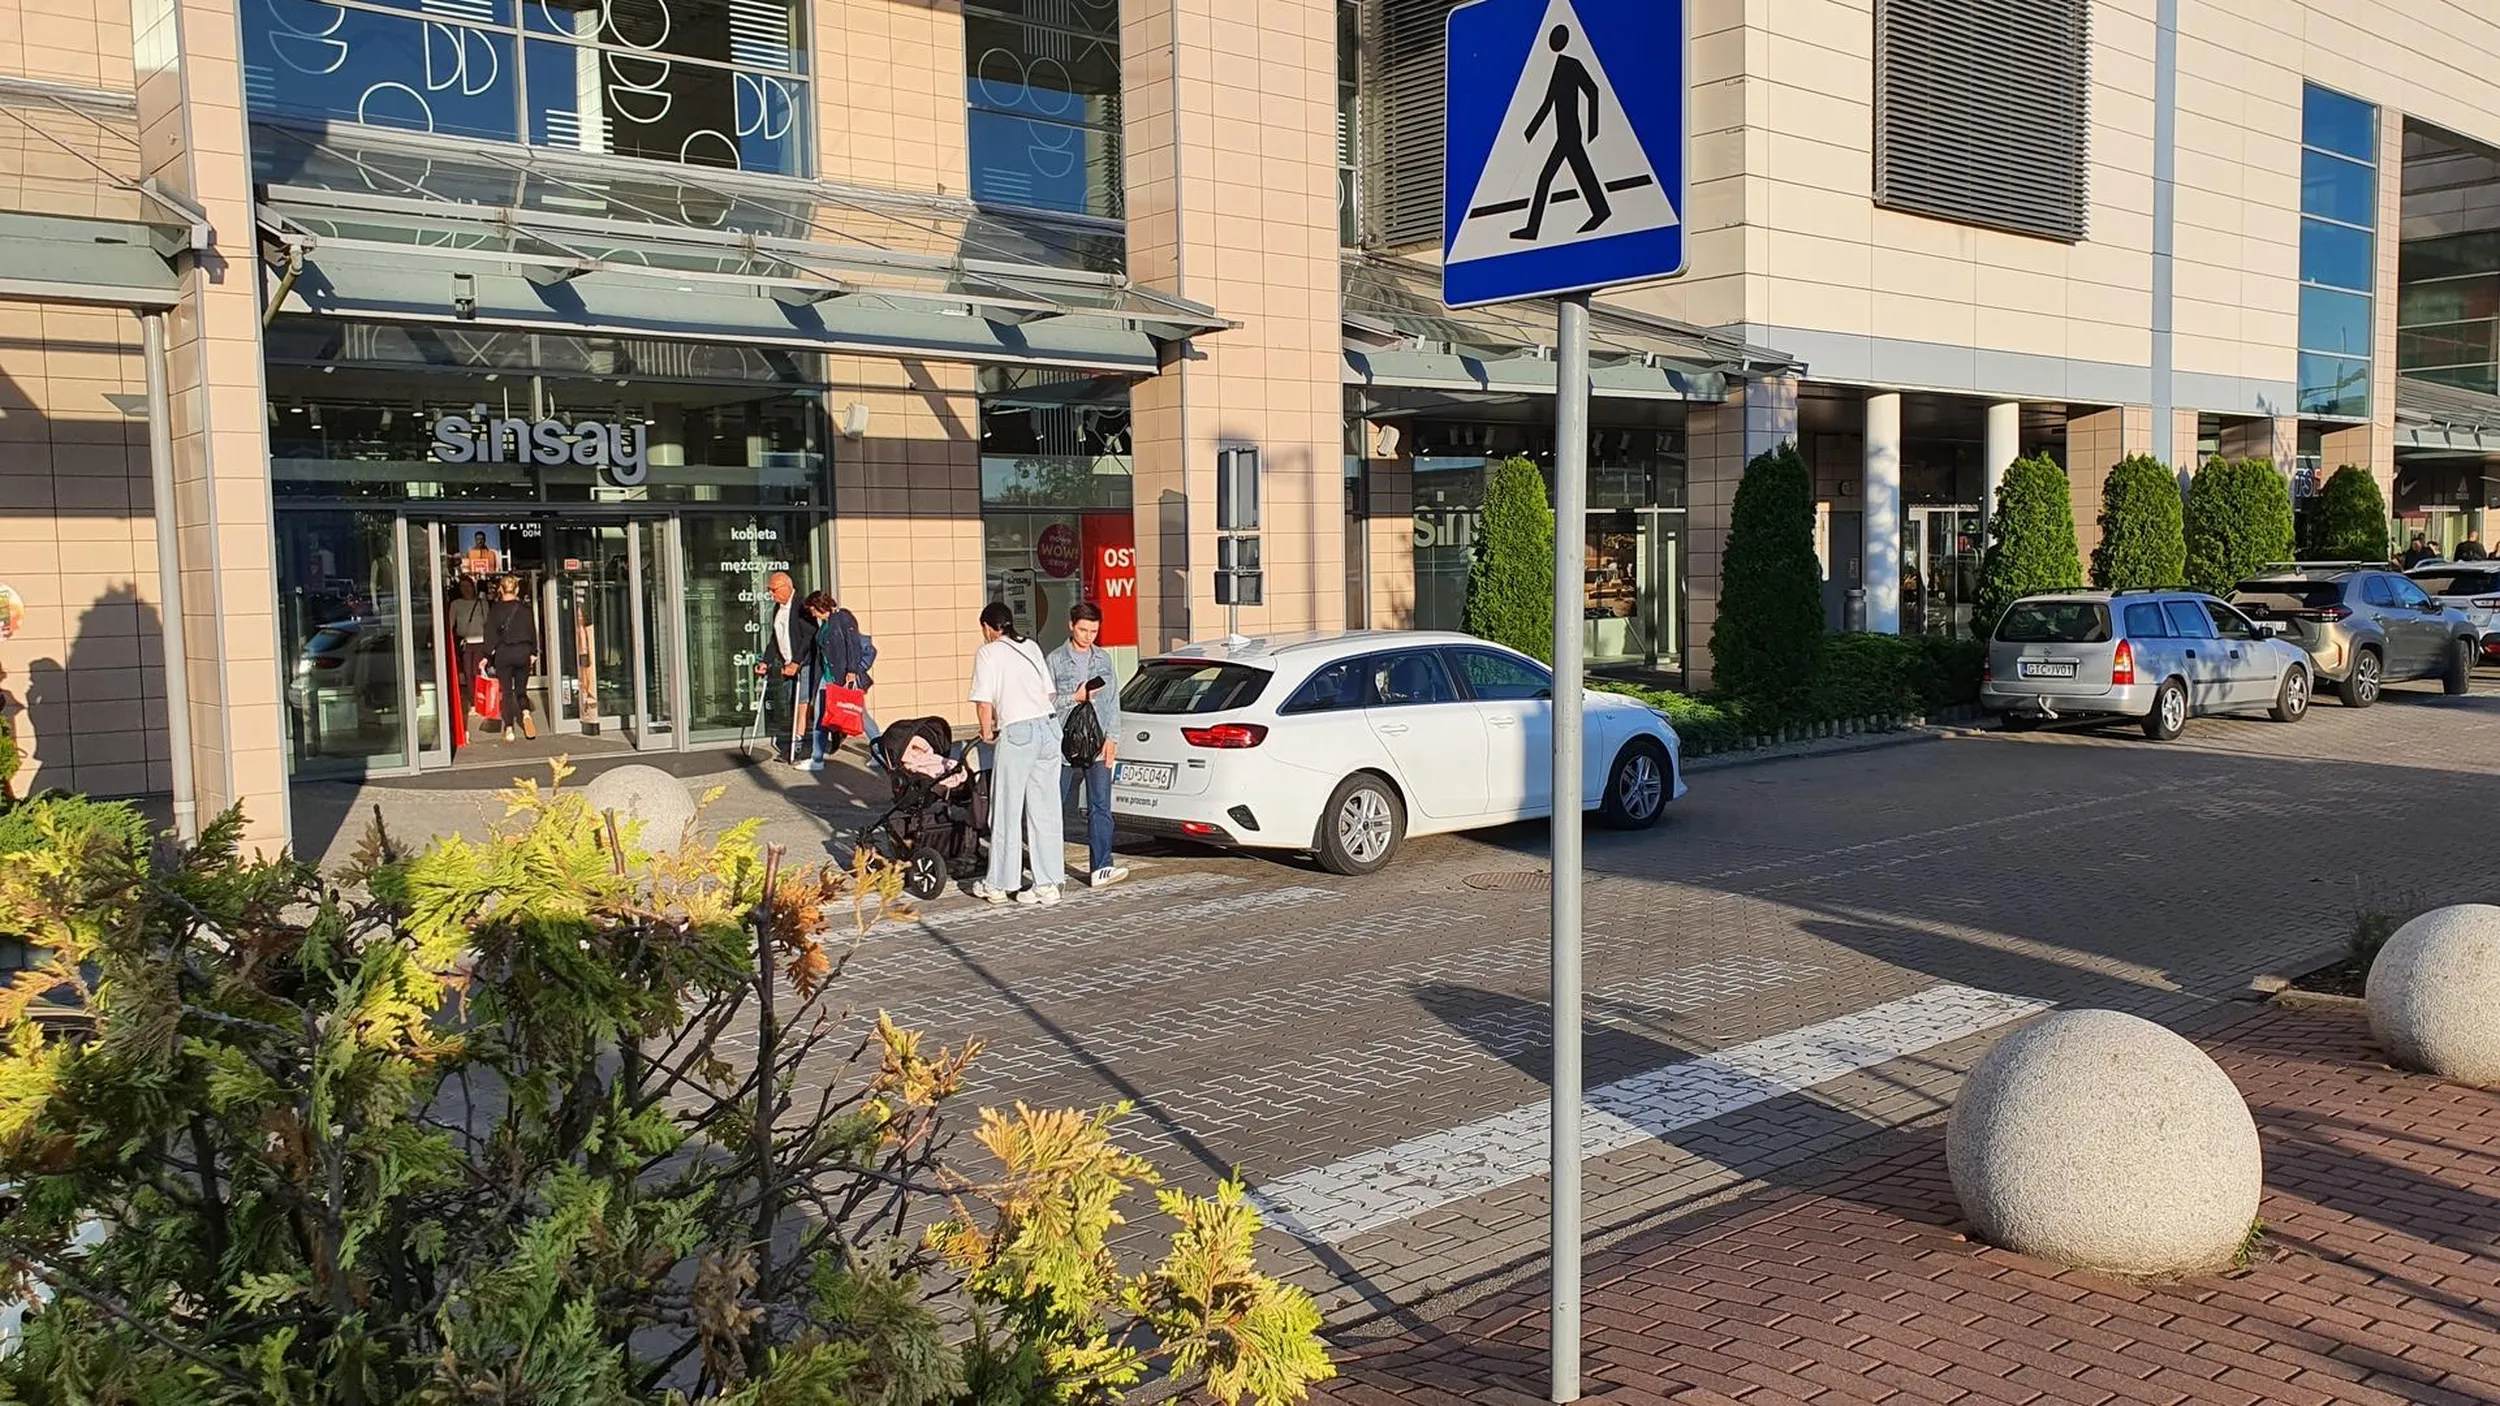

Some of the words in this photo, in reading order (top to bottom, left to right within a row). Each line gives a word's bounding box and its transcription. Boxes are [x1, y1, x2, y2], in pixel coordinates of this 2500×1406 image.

[435, 403, 646, 485] sinsay
[731, 527, 777, 540] kobieta
[720, 558, 790, 573] mężczyzna
[1105, 578, 1135, 598] WY
